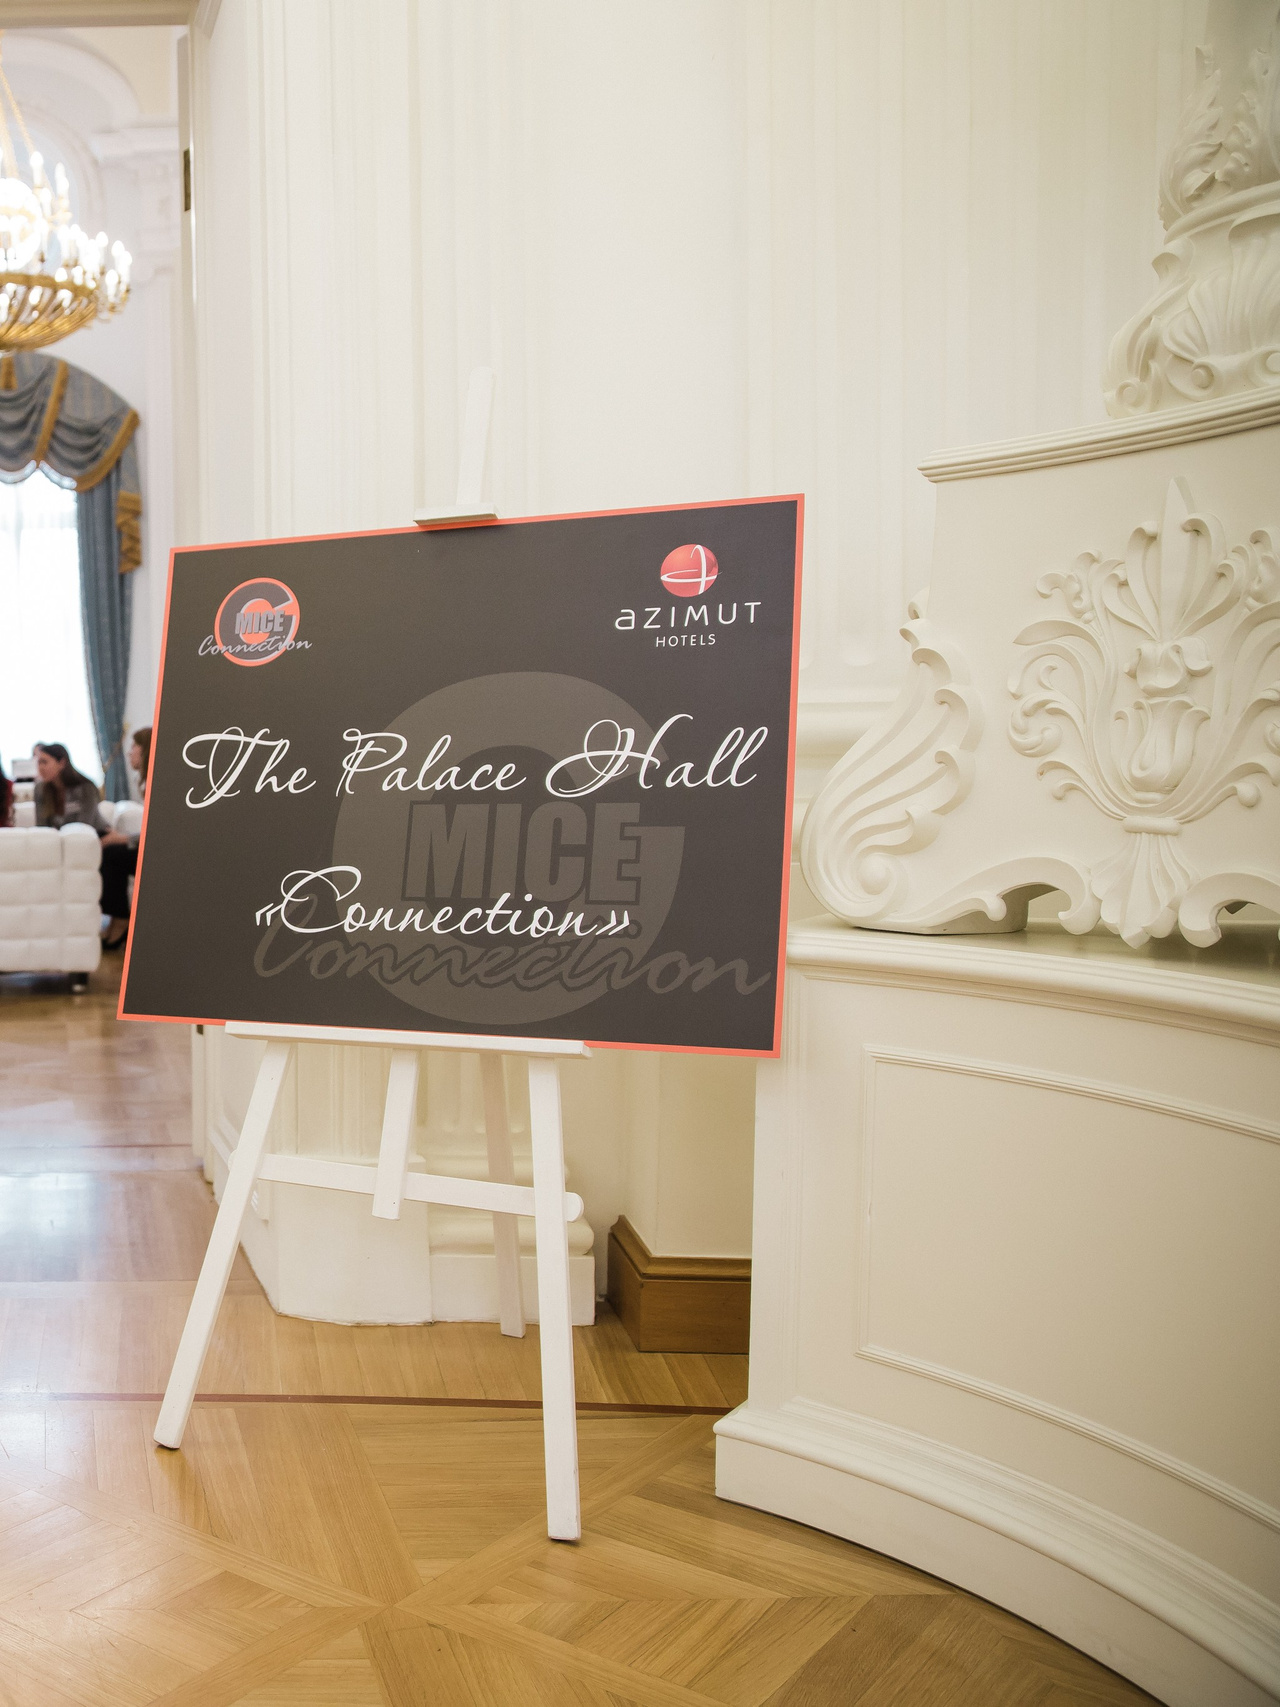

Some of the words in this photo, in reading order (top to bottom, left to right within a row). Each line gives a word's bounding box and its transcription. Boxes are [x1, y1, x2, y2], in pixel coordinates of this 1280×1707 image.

[198, 634, 313, 656] Connection
[234, 610, 285, 635] MICE
[655, 633, 716, 648] HOTELS
[182, 726, 317, 809] The
[335, 728, 527, 798] Palace
[545, 713, 769, 798] Hall
[401, 800, 643, 906] MICE
[253, 892, 773, 997] Connection
